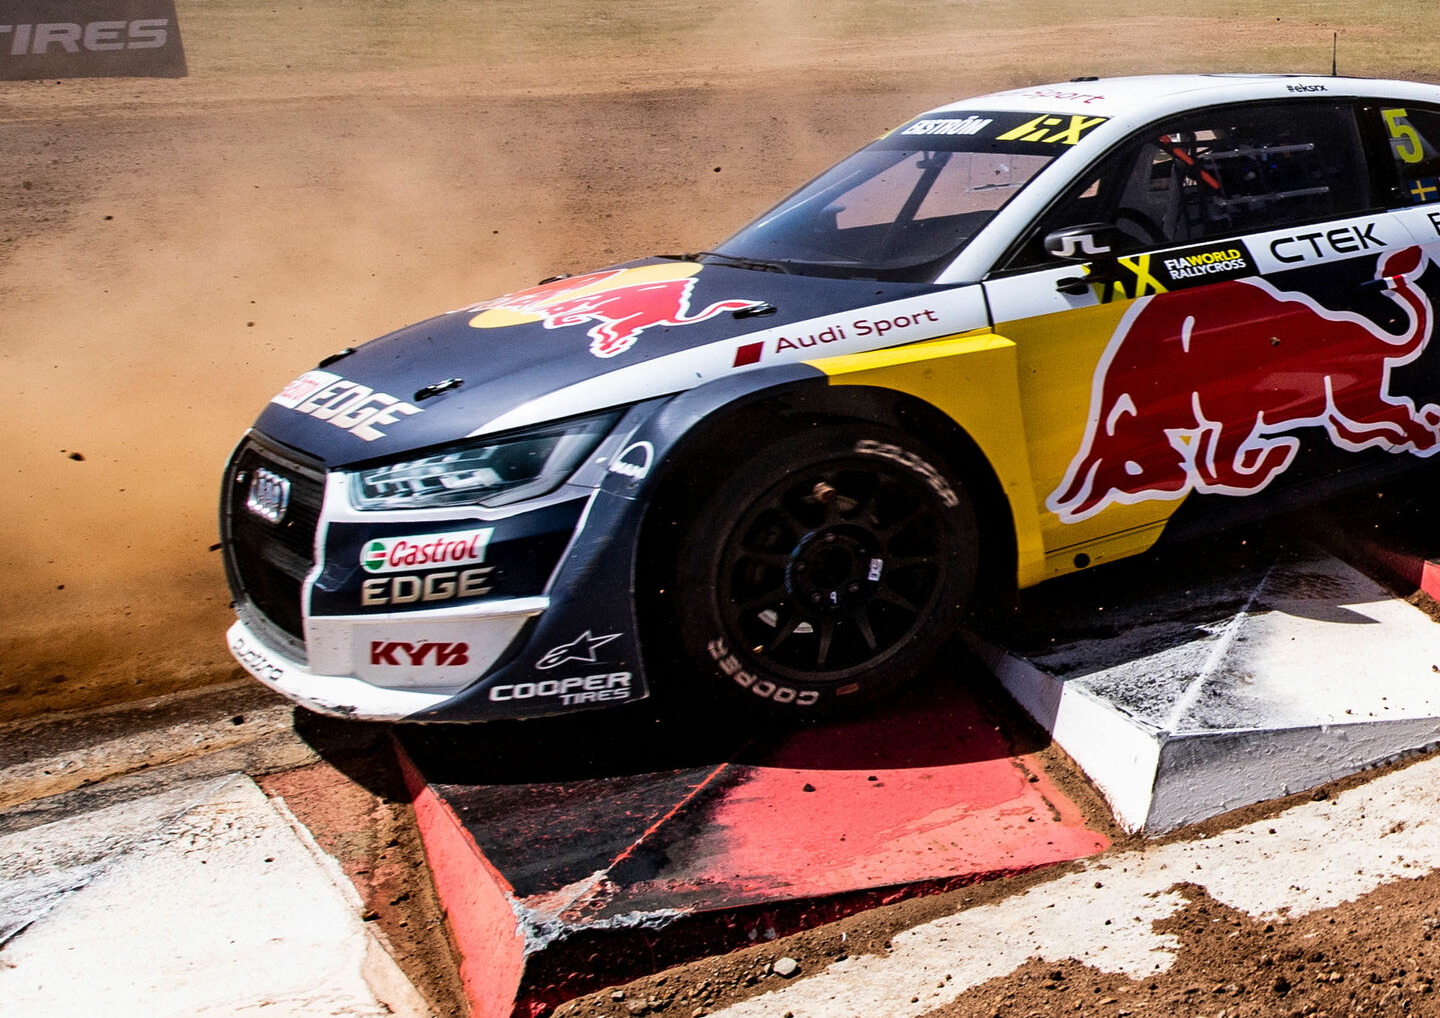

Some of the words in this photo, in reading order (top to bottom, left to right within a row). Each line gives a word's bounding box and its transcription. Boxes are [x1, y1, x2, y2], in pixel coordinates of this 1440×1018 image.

[1381, 108, 1424, 164] 5
[1270, 222, 1388, 263] CTEK
[1170, 258, 1247, 280] RALLYCROSS
[775, 324, 847, 354] Audi
[852, 308, 940, 337] Sport
[294, 379, 426, 442] EDGE
[389, 534, 481, 567] Castrol
[361, 566, 497, 607] EDGE
[370, 640, 470, 667] KYB
[707, 636, 821, 706] COOPER
[489, 671, 633, 702] COOPER
[558, 686, 632, 706] TIRES
